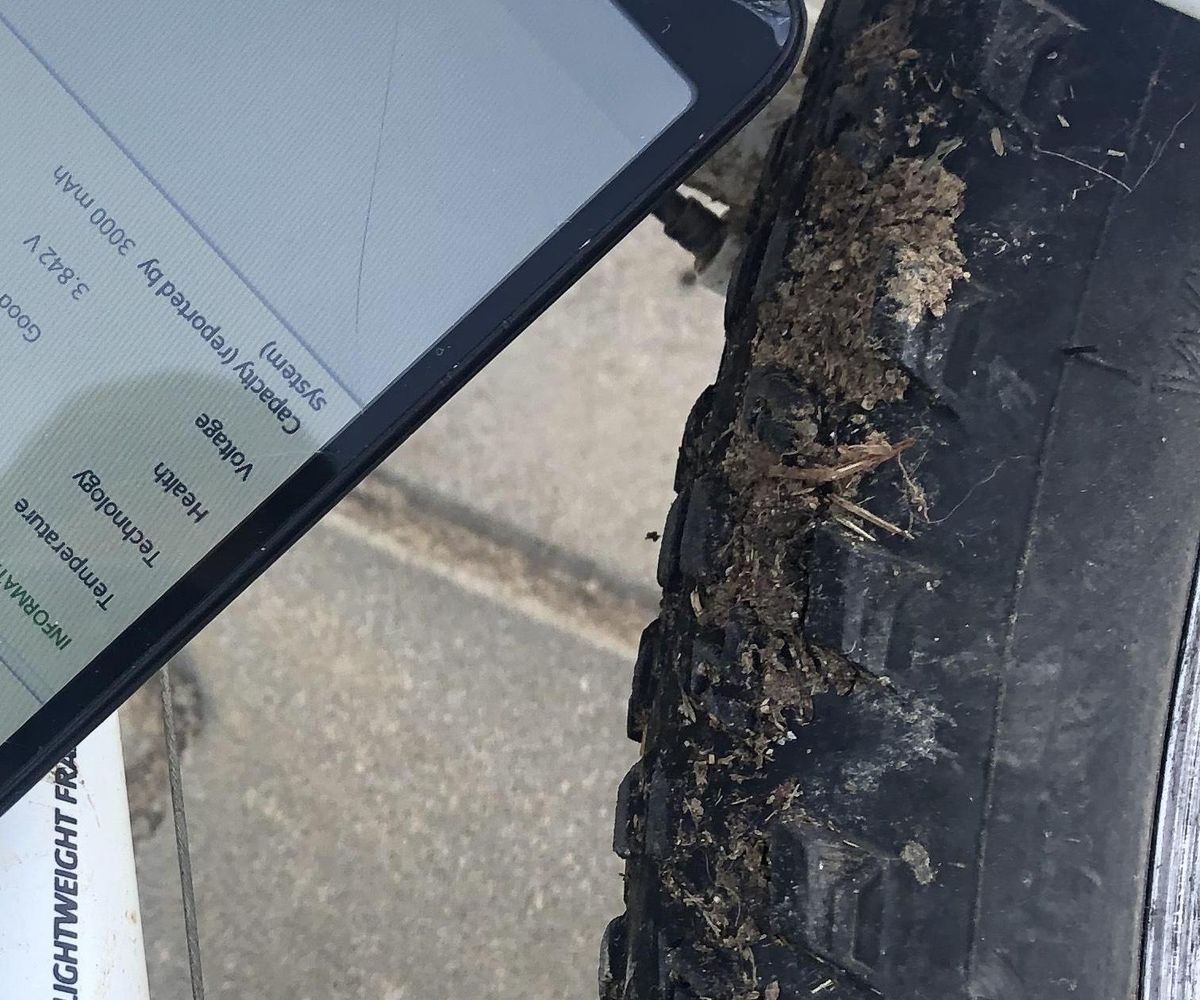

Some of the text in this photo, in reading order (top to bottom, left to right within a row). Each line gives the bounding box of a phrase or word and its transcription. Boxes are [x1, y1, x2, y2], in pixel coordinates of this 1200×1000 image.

[52, 164, 136, 256] 3000 mAh
[22, 233, 90, 301] 3.842 V
[136, 257, 301, 435] Capacity (reported by
[258, 340, 327, 411] system)
[194, 412, 253, 482] Voltage
[71, 468, 160, 569] Technology
[153, 461, 209, 523] Health
[13, 497, 114, 611] Temperature
